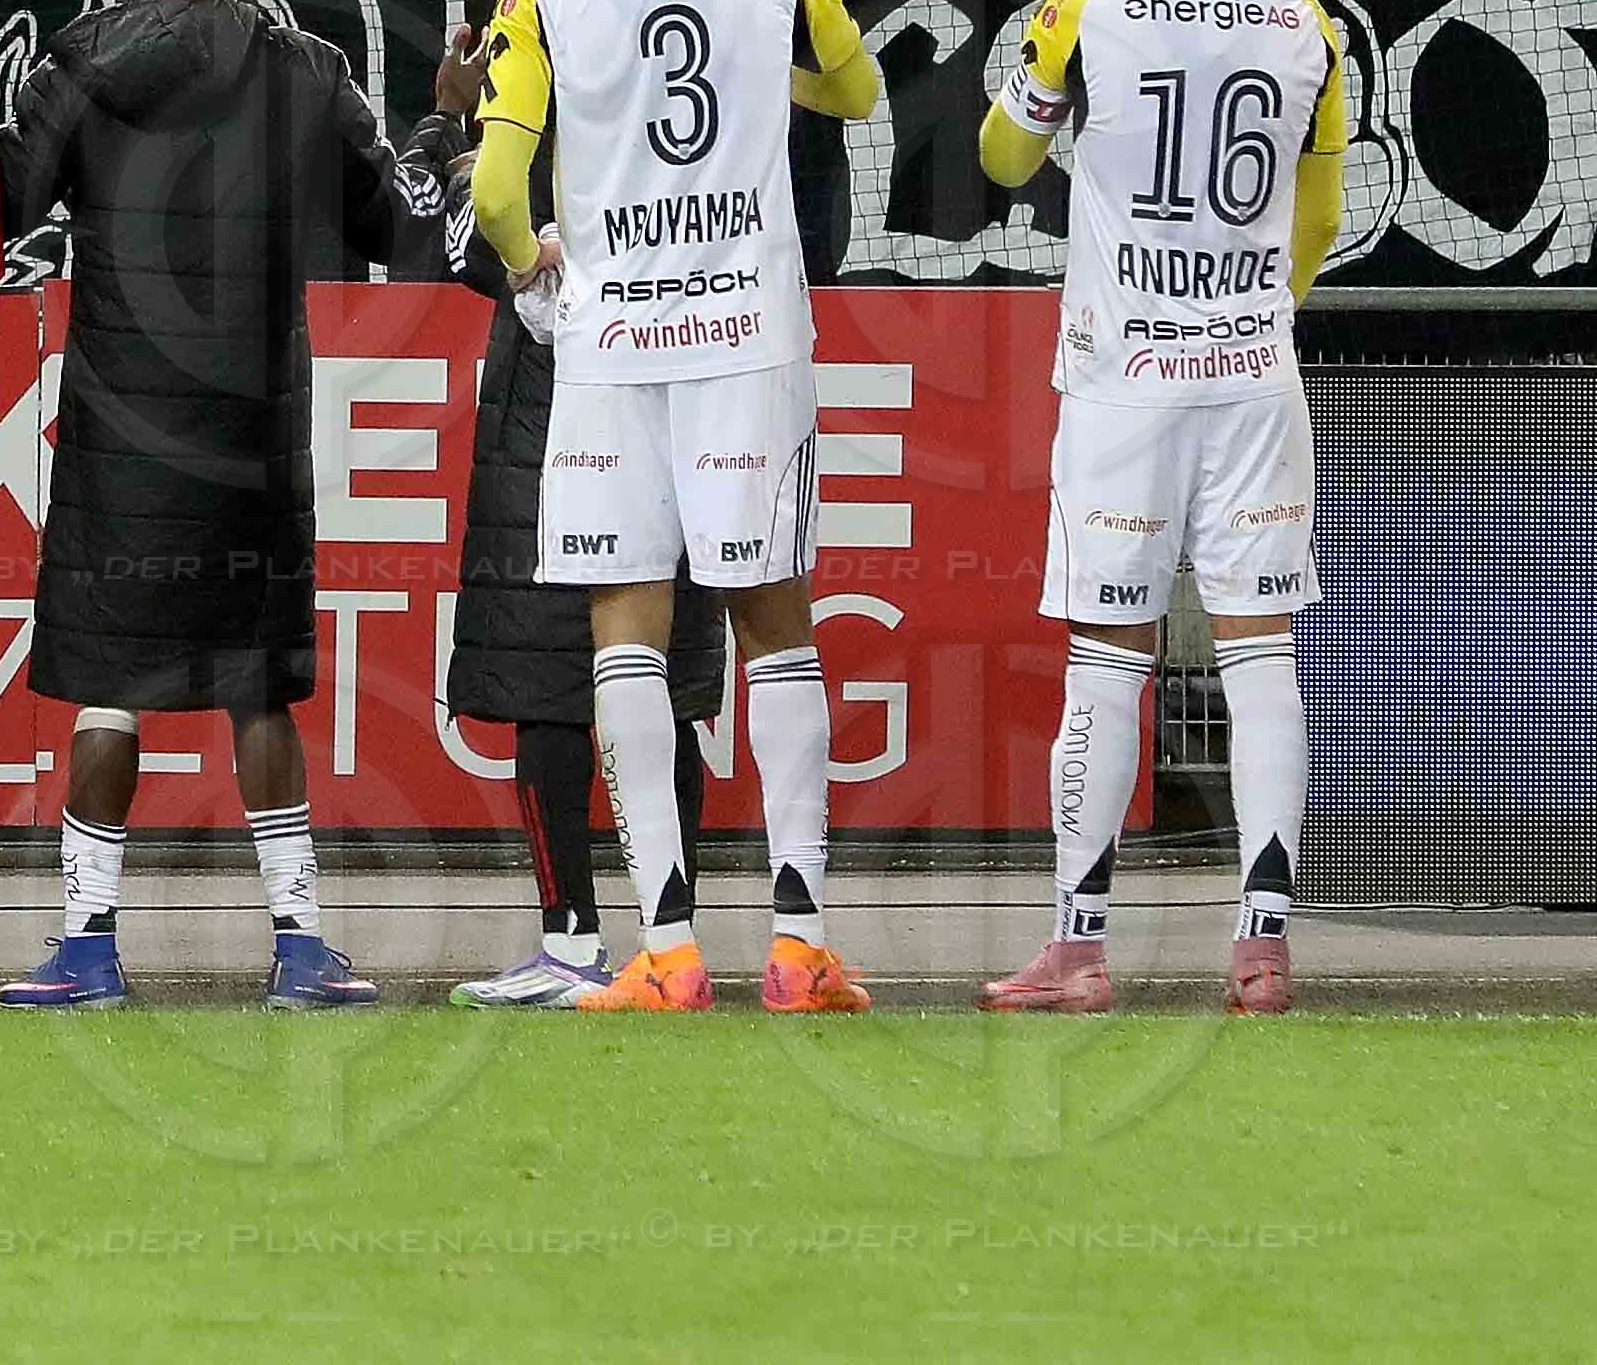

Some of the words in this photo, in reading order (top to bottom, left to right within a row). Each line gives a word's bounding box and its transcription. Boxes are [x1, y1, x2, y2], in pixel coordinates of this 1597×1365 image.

[639, 2, 721, 166] 3
[1131, 68, 1283, 228] 16
[603, 187, 763, 256] MBUYAMBA
[600, 266, 760, 303] ASPÖCK
[1117, 243, 1281, 300] ANDRADE
[631, 308, 763, 350] windhager
[1124, 310, 1277, 340] ASPÖCK
[1159, 343, 1279, 382] windhager
[563, 534, 619, 556] BWT
[1069, 705, 1095, 758] LUCE
